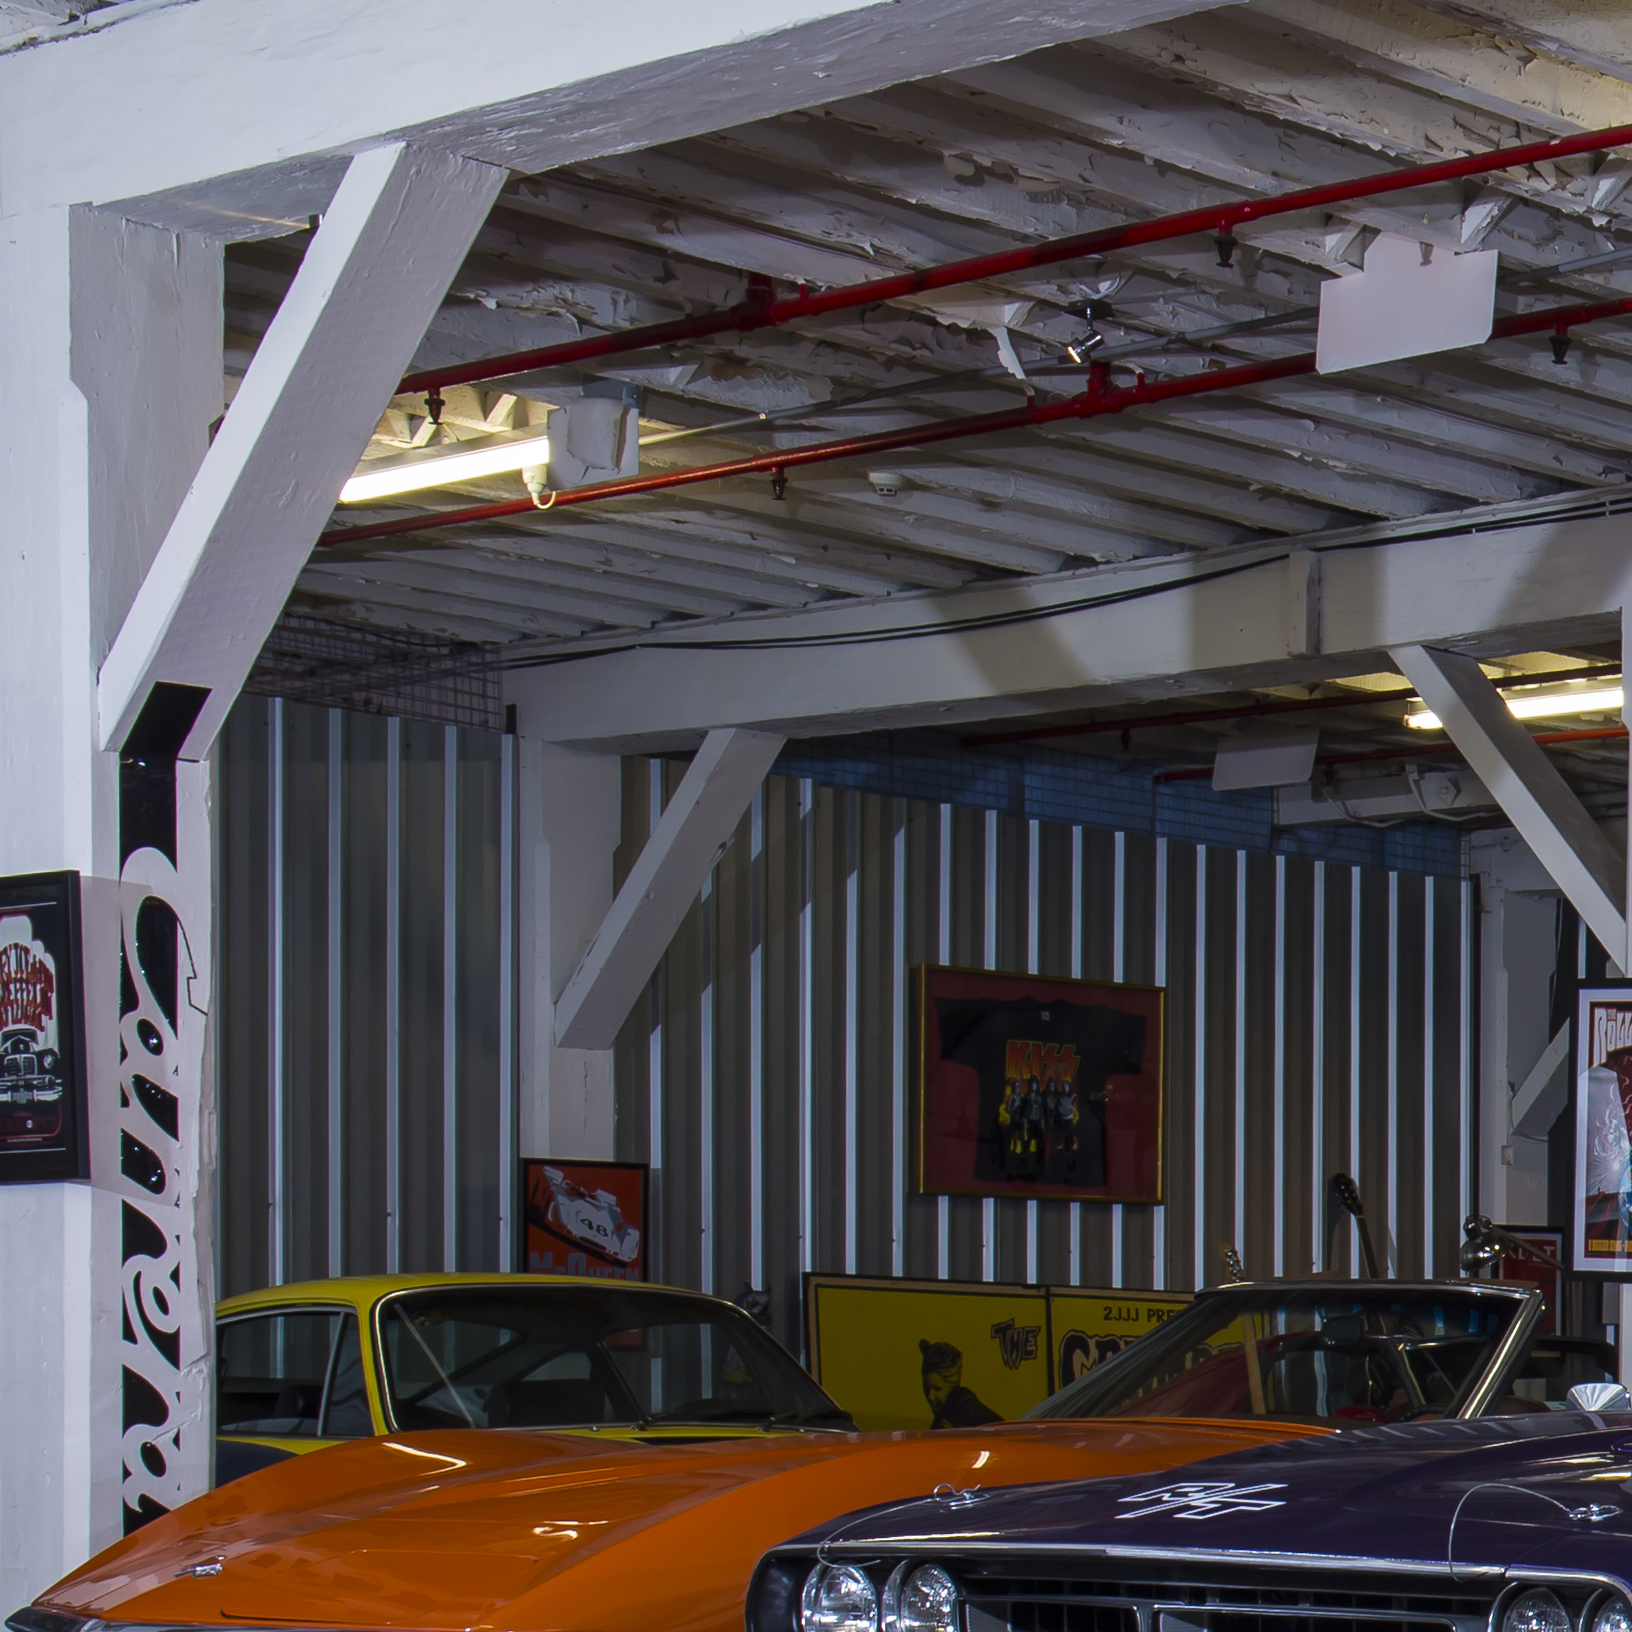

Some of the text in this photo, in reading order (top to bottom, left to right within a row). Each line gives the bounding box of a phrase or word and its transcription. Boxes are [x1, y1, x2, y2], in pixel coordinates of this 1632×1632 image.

[1006, 1040, 1081, 1087] KISS
[579, 1217, 608, 1237] 48
[1102, 1305, 1140, 1322] 2JJJ
[990, 1317, 1042, 1371] THE
